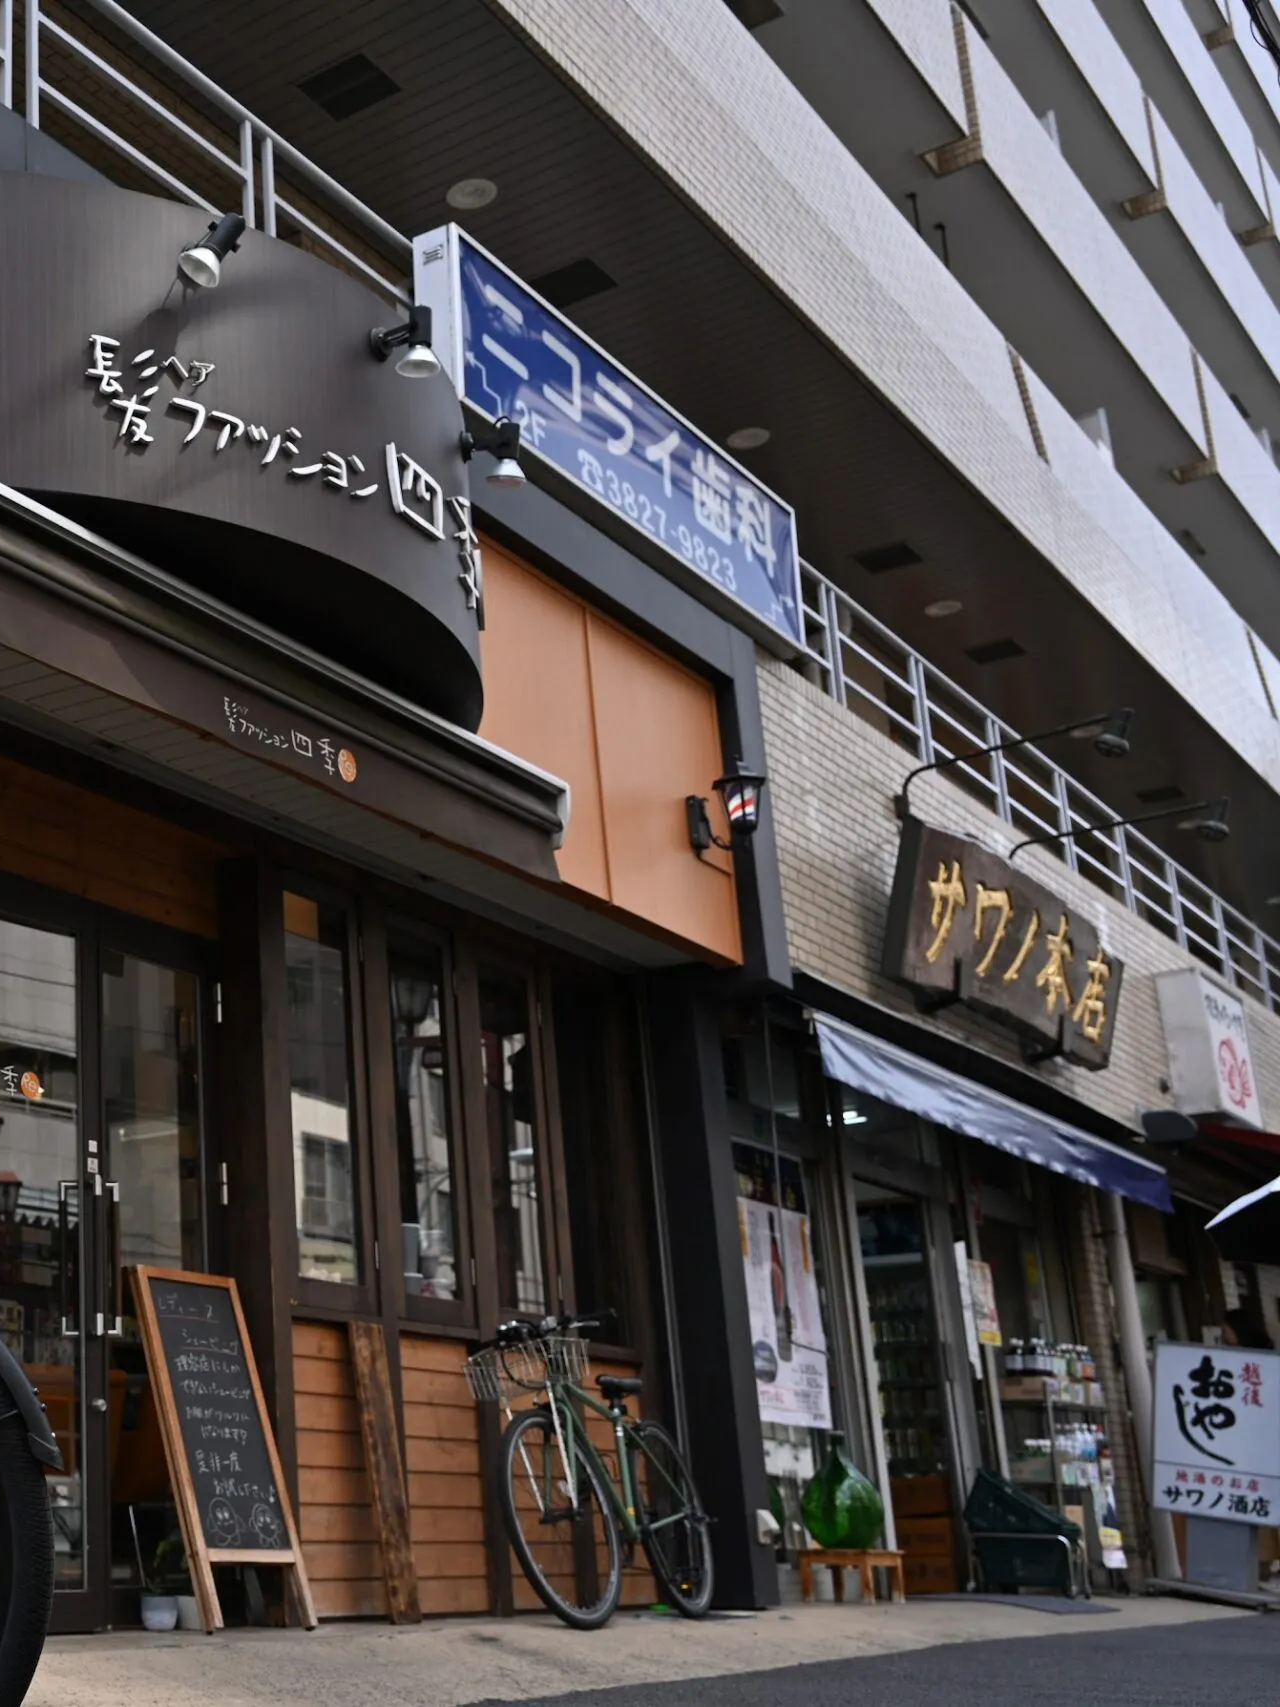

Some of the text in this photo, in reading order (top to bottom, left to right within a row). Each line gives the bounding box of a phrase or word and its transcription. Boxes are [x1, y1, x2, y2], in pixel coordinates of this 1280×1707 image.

[482, 283, 777, 577] ニコライ歯科
[519, 400, 547, 447] 2F
[603, 472, 738, 592] 3827-9823
[926, 861, 1111, 1044] サワノ本店
[194, 1449, 243, 1475] 是非一度
[1162, 1485, 1272, 1517] サワノ酒店
